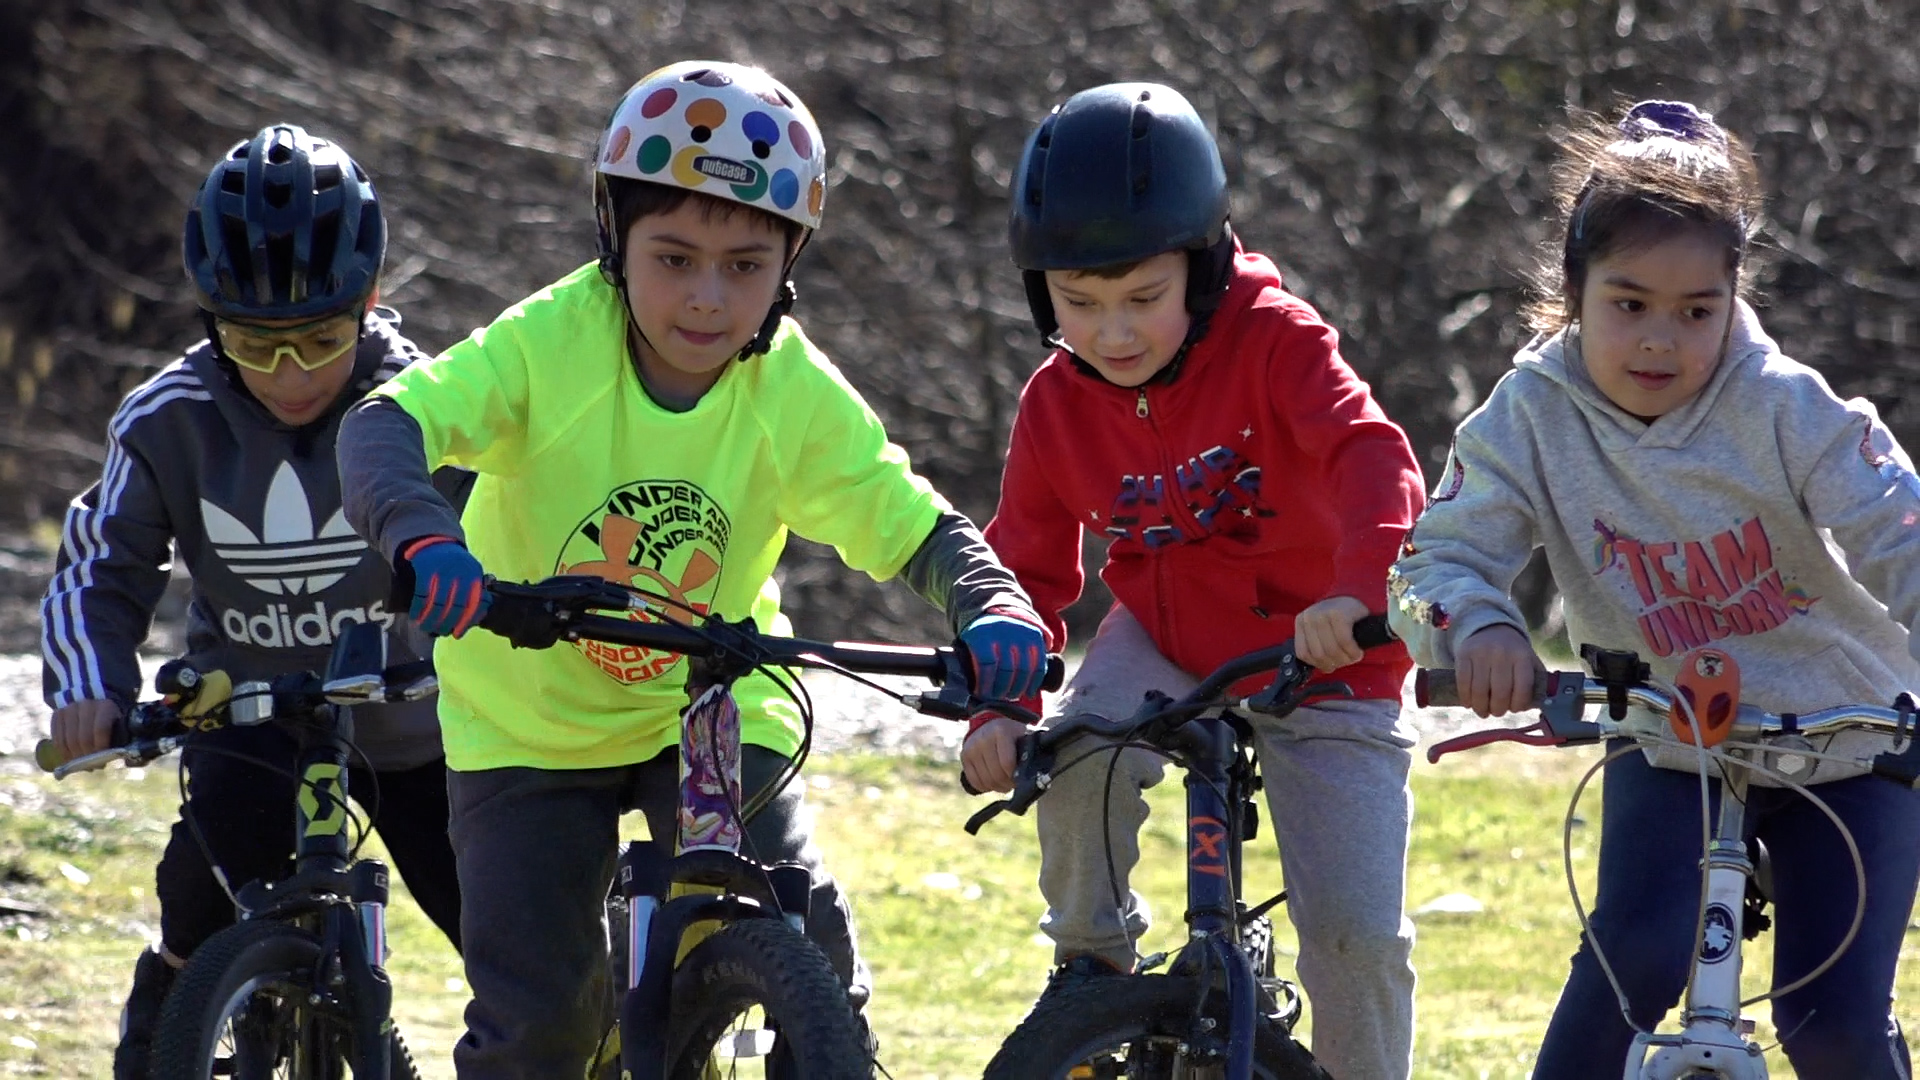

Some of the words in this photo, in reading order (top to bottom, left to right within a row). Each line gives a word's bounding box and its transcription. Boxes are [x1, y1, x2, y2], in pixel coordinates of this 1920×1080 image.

[701, 158, 748, 181] nutcase
[1615, 516, 1773, 608] TEAM
[1637, 569, 1797, 657] UNICORN
